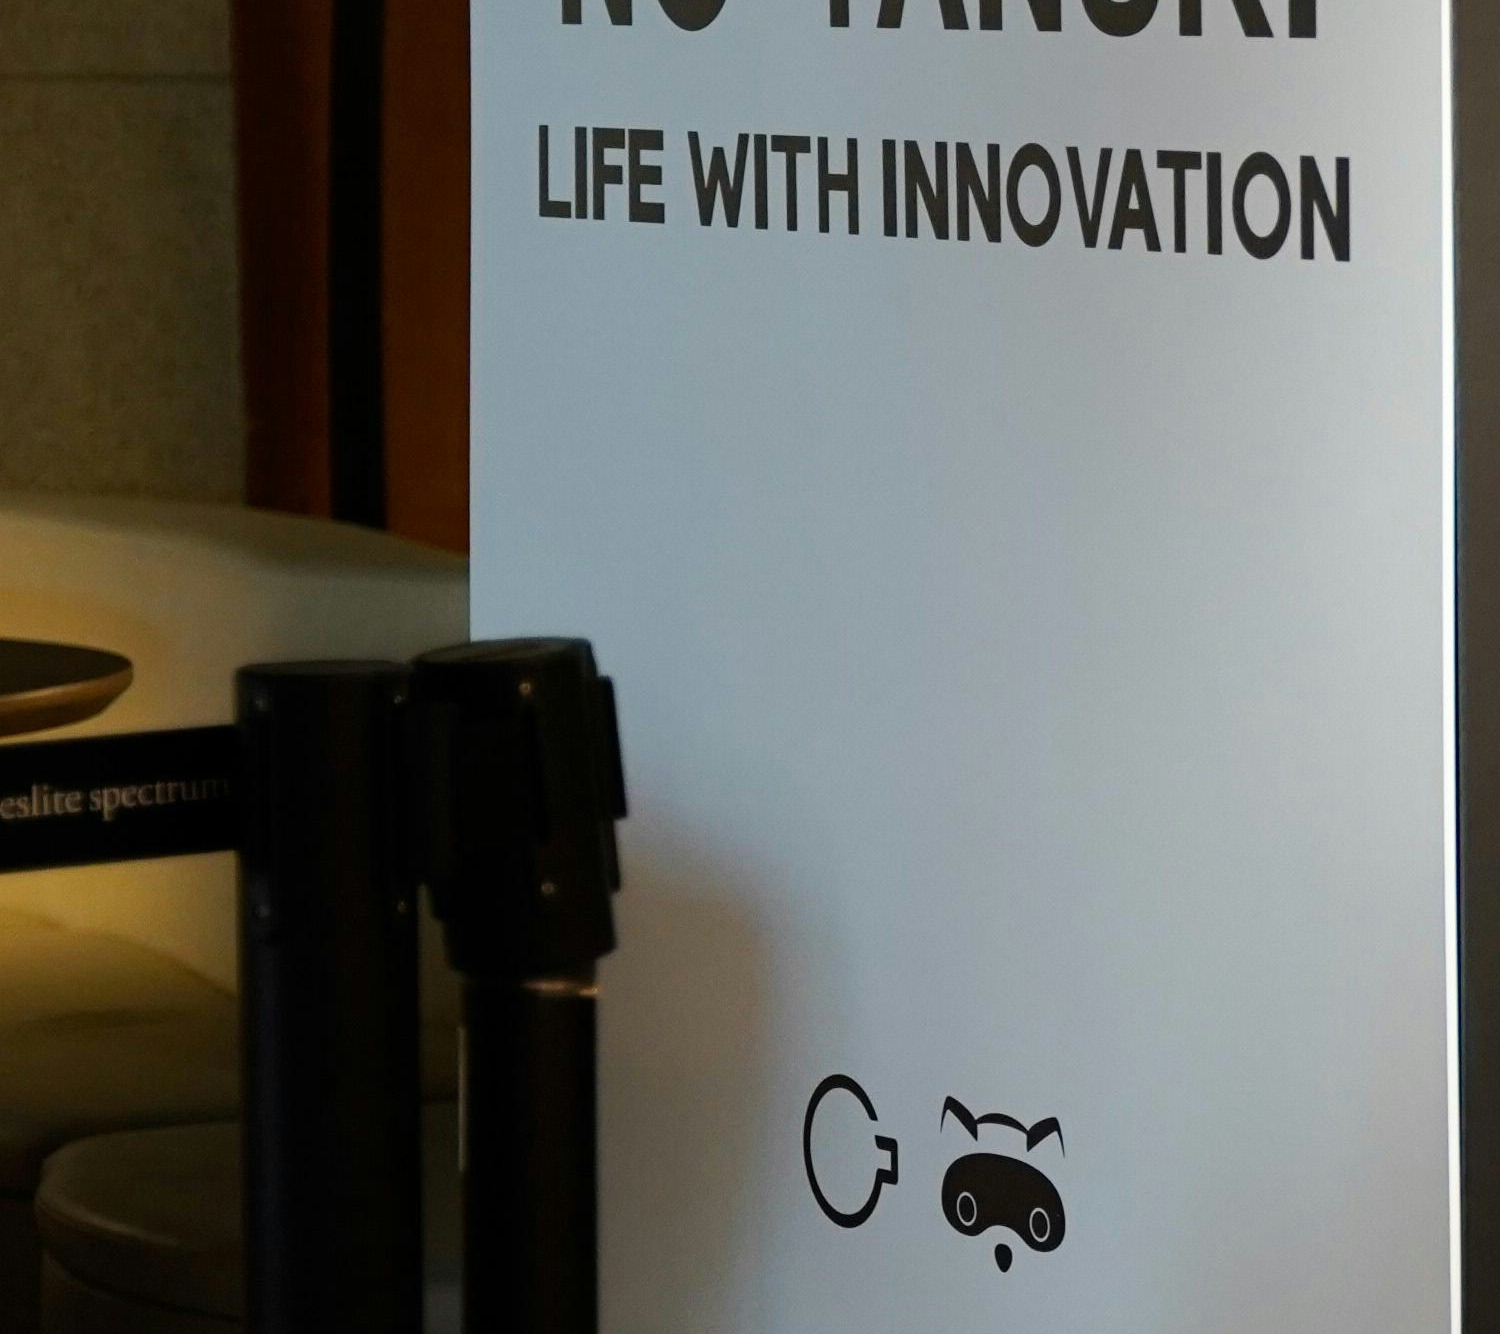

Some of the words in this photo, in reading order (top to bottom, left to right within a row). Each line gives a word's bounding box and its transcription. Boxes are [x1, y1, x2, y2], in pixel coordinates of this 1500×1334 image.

[538, 124, 666, 225] LIFE
[687, 130, 860, 236] WITH
[881, 138, 1350, 262] INNOVATION
[0, 783, 83, 819] eslite
[89, 779, 232, 821] spectrum
